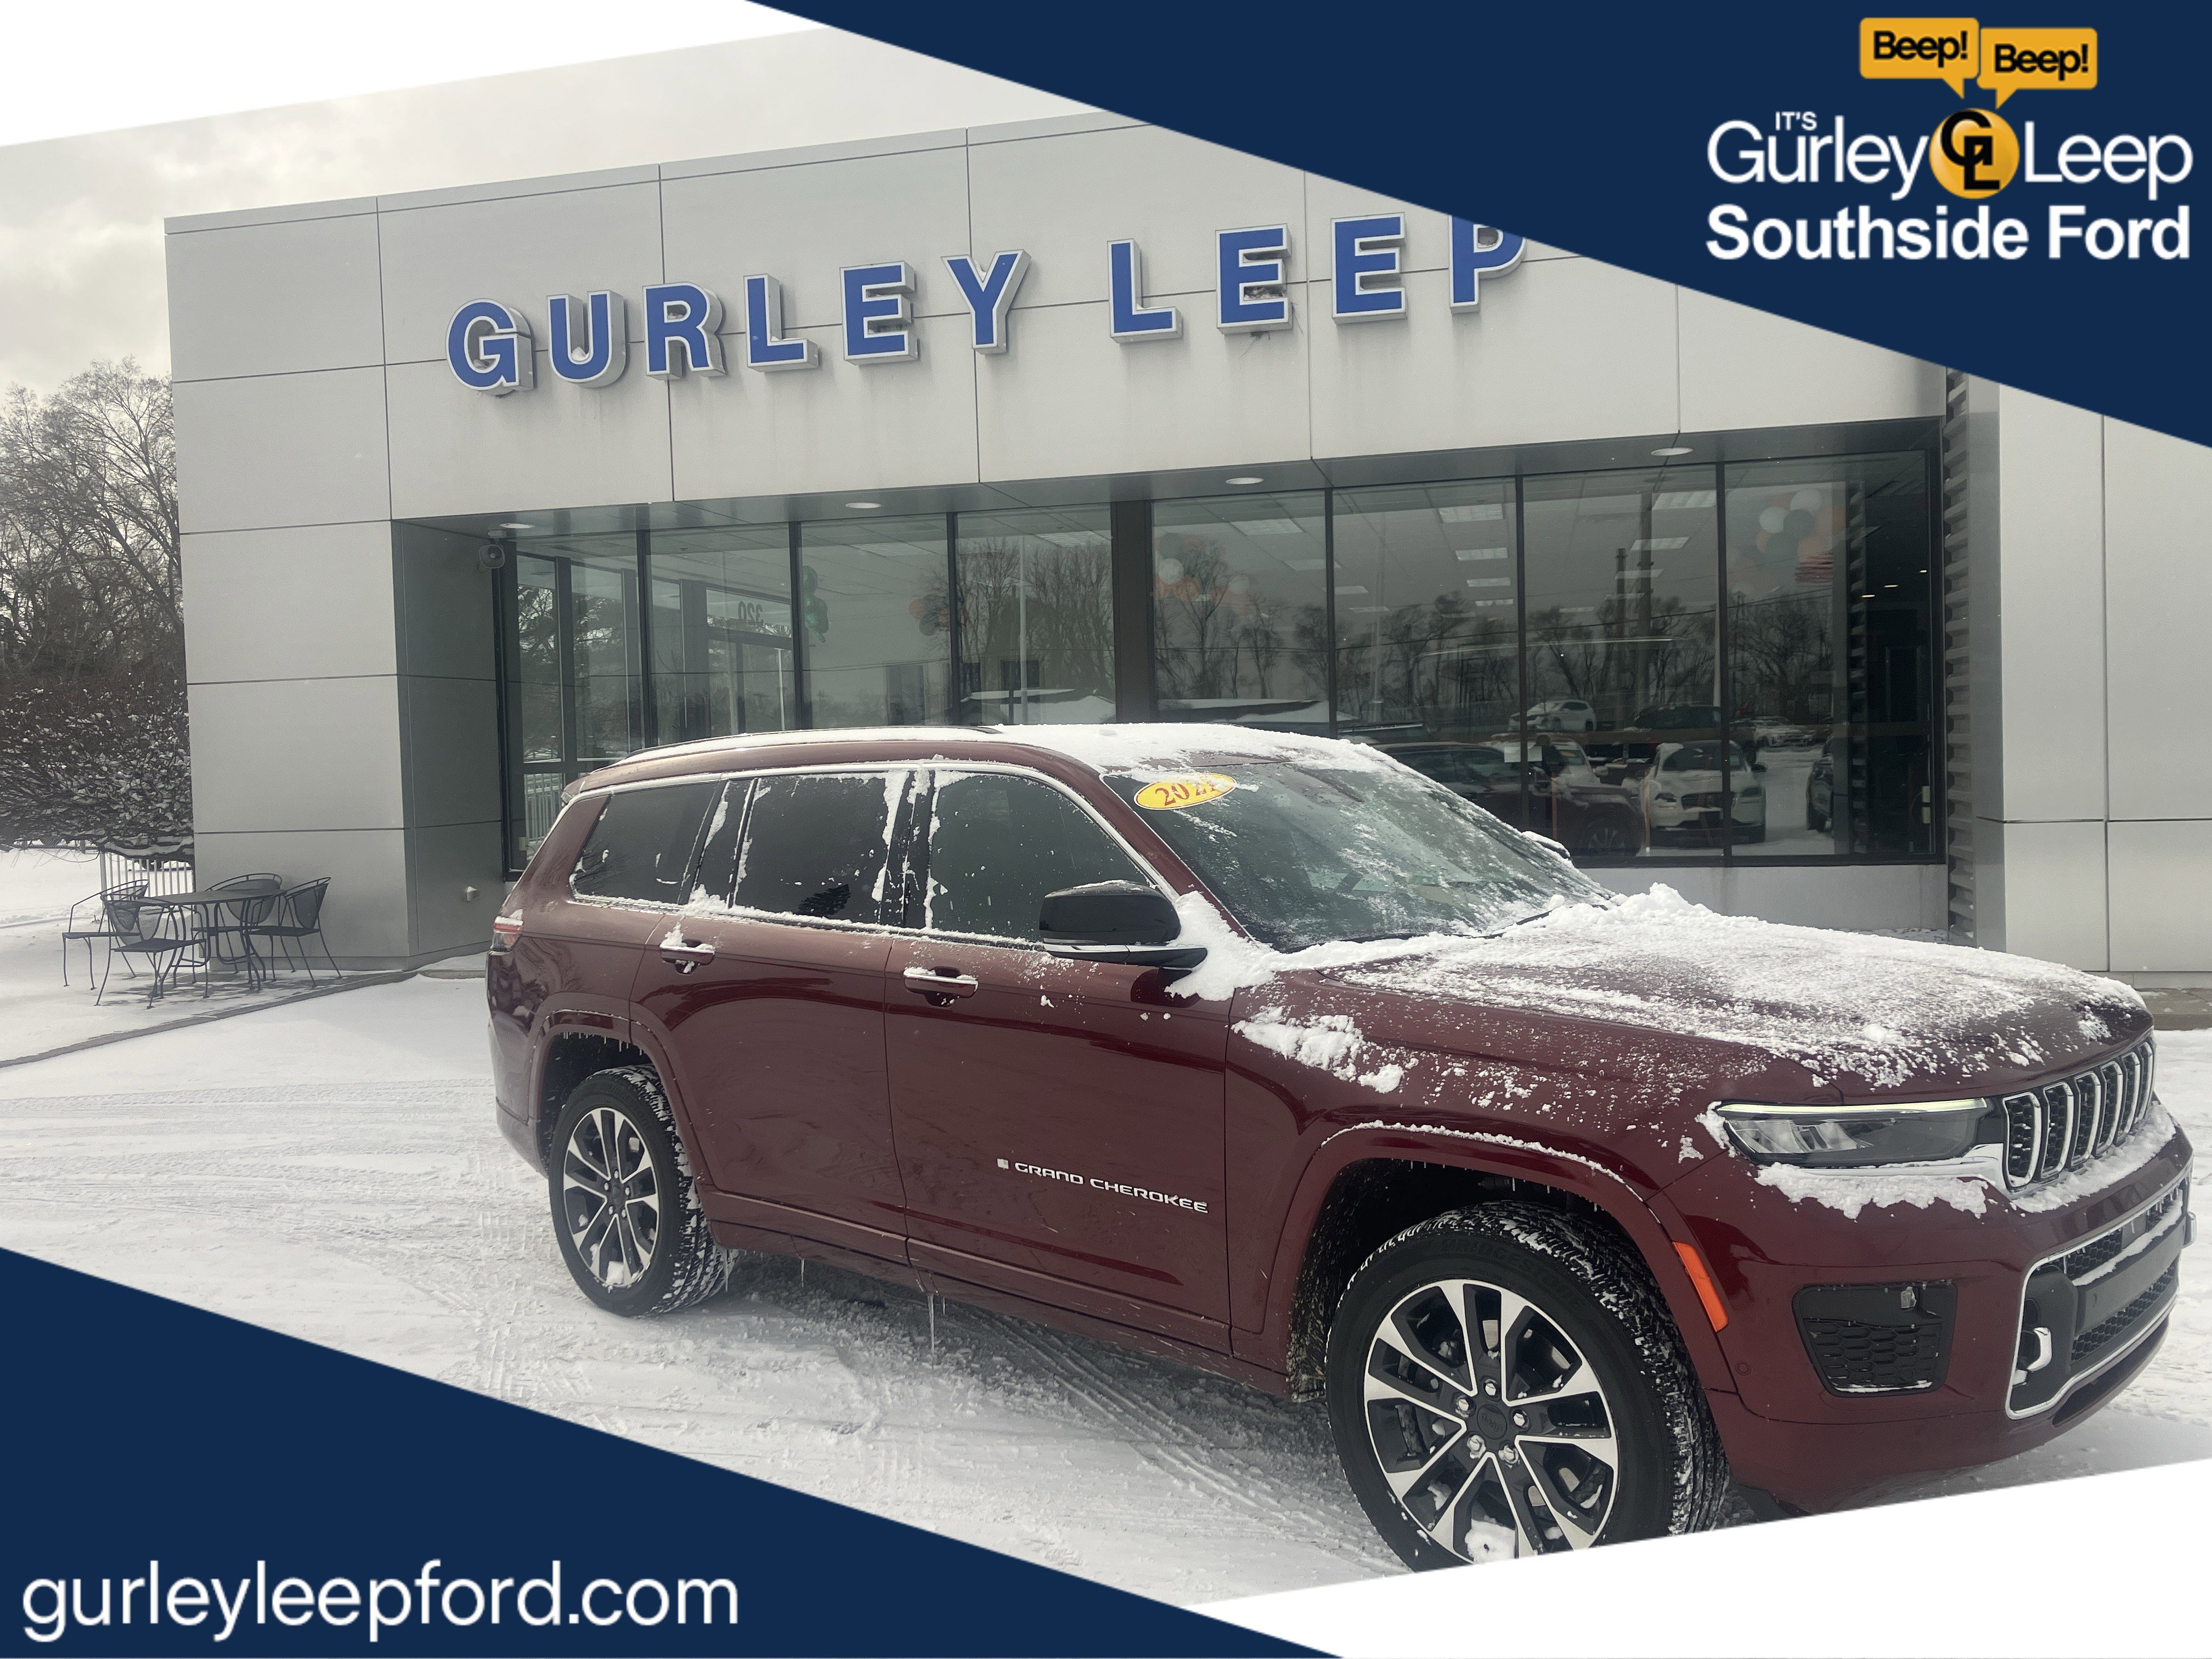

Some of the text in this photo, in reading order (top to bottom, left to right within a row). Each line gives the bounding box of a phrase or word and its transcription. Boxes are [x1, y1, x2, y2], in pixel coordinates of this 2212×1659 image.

[445, 212, 1527, 394] GURLEY LEEP
[1014, 1161, 1209, 1214] GRAND CHEROKEE
